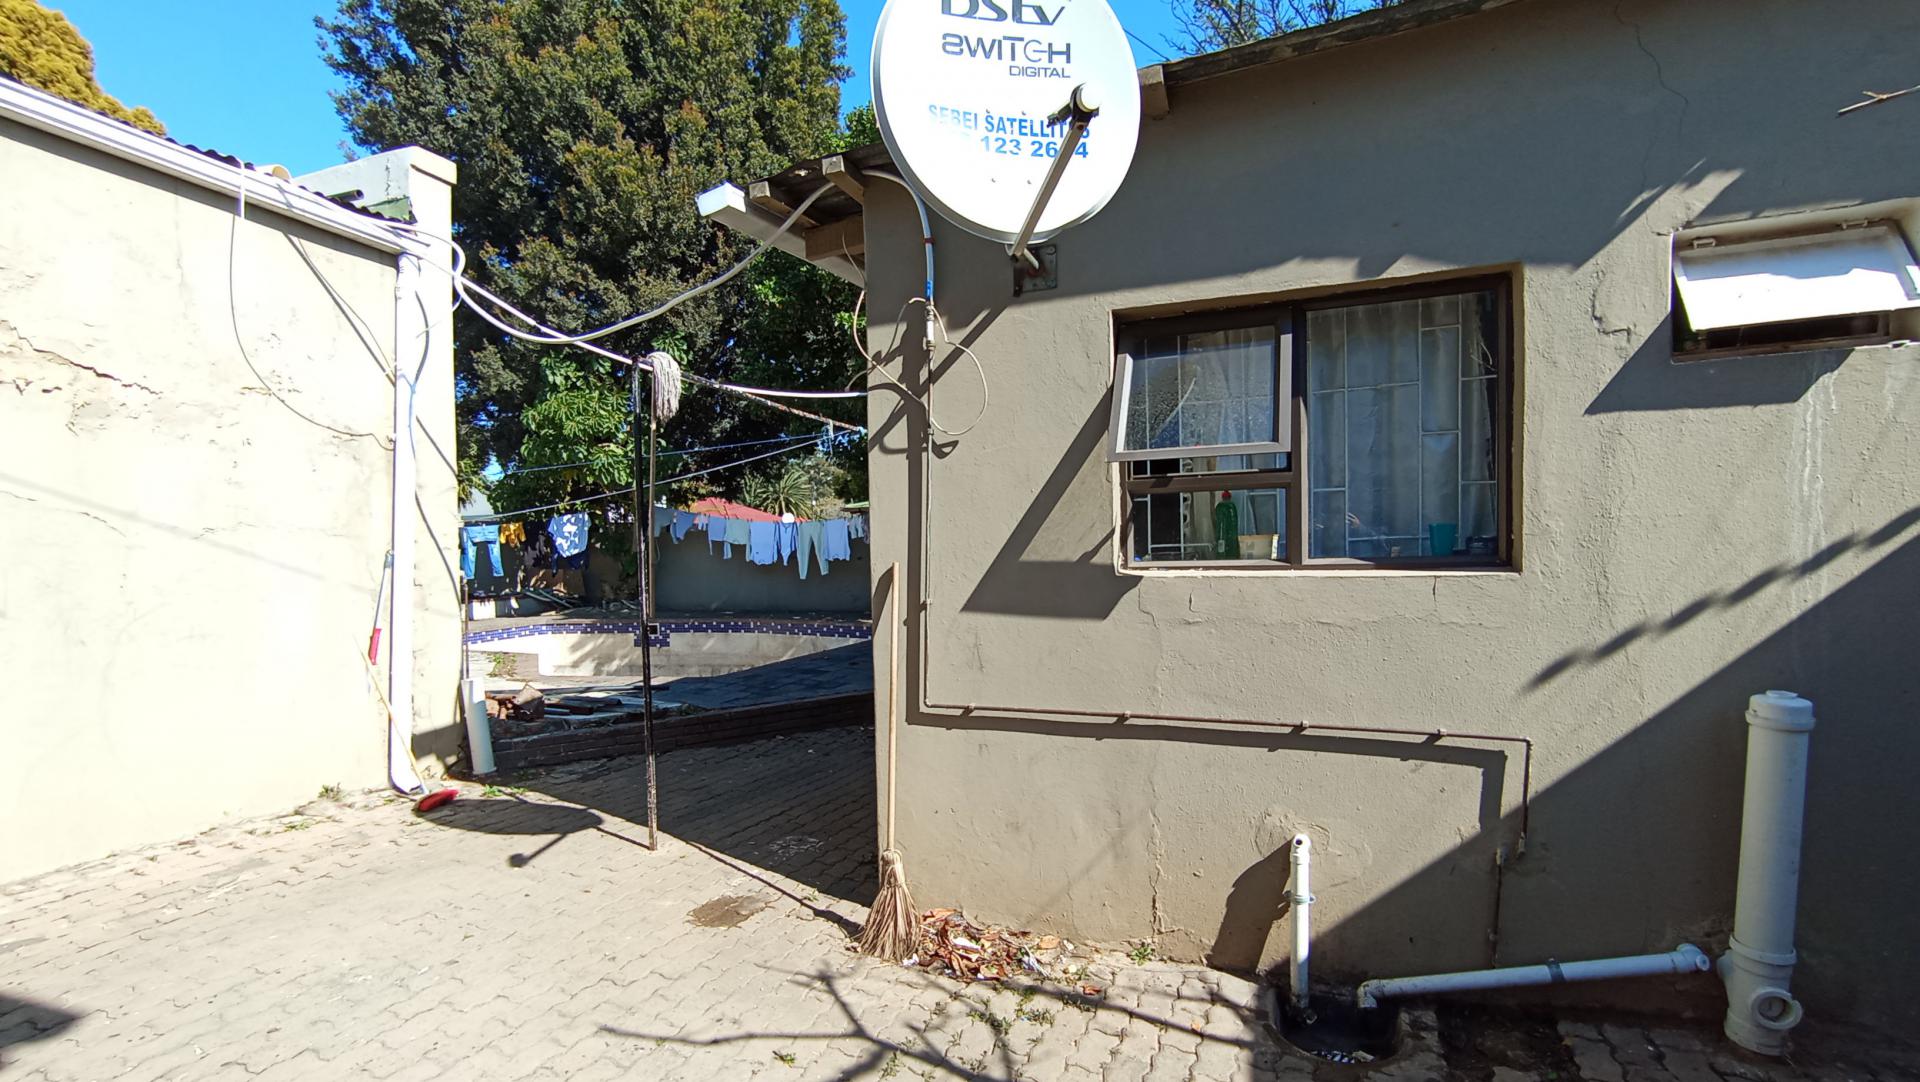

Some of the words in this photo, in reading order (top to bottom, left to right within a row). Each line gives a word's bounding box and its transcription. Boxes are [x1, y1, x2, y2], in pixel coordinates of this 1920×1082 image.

[941, 32, 1071, 64] SWITCH
[1009, 65, 1071, 79] DIGITAL
[984, 114, 1090, 139] SATELLIT
[980, 135, 1022, 156] 123
[1030, 140, 1089, 159] 264
